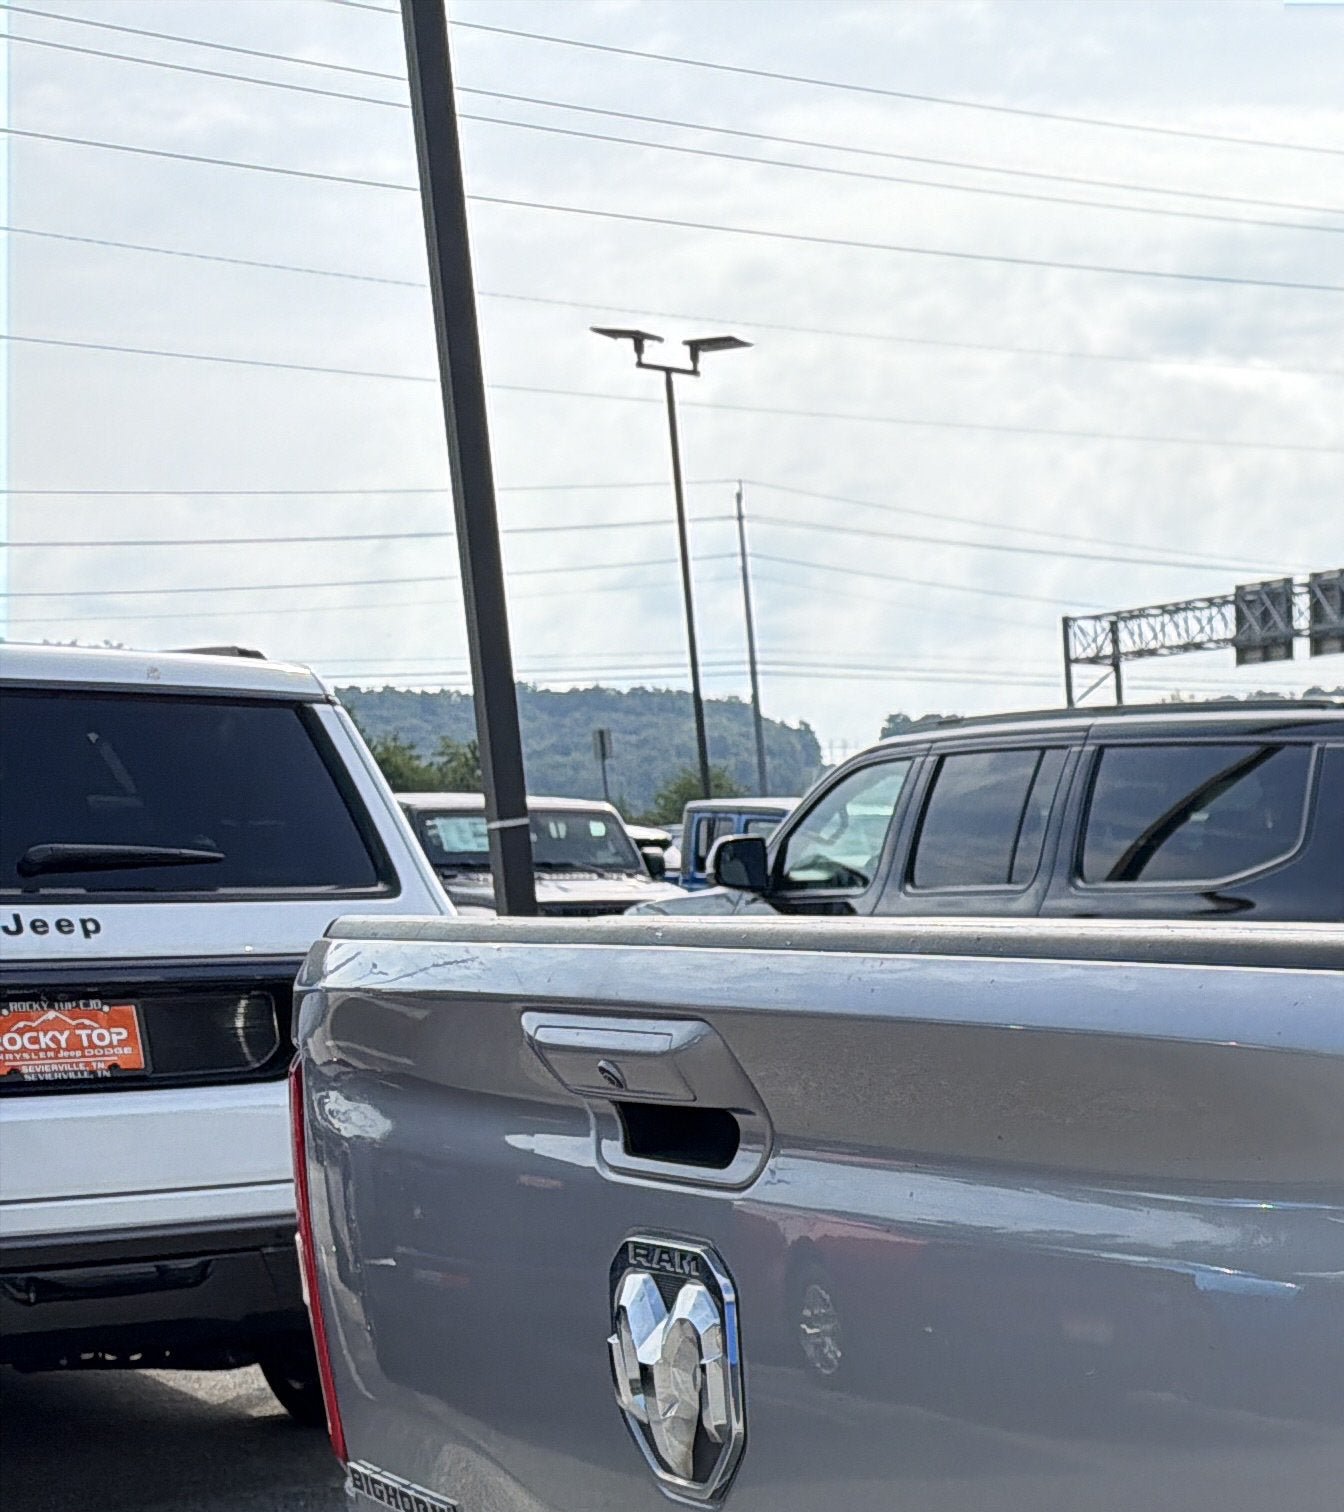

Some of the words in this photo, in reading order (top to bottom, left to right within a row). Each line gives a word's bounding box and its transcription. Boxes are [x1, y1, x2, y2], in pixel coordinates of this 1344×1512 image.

[1, 913, 101, 938] Jeep
[9, 1001, 49, 1012] ROCKY
[0, 1029, 70, 1051] OCKY
[75, 1027, 128, 1047] TOP
[58, 1049, 82, 1058] Jeep
[84, 1046, 132, 1056] DODGE
[628, 1242, 700, 1276] RAM
